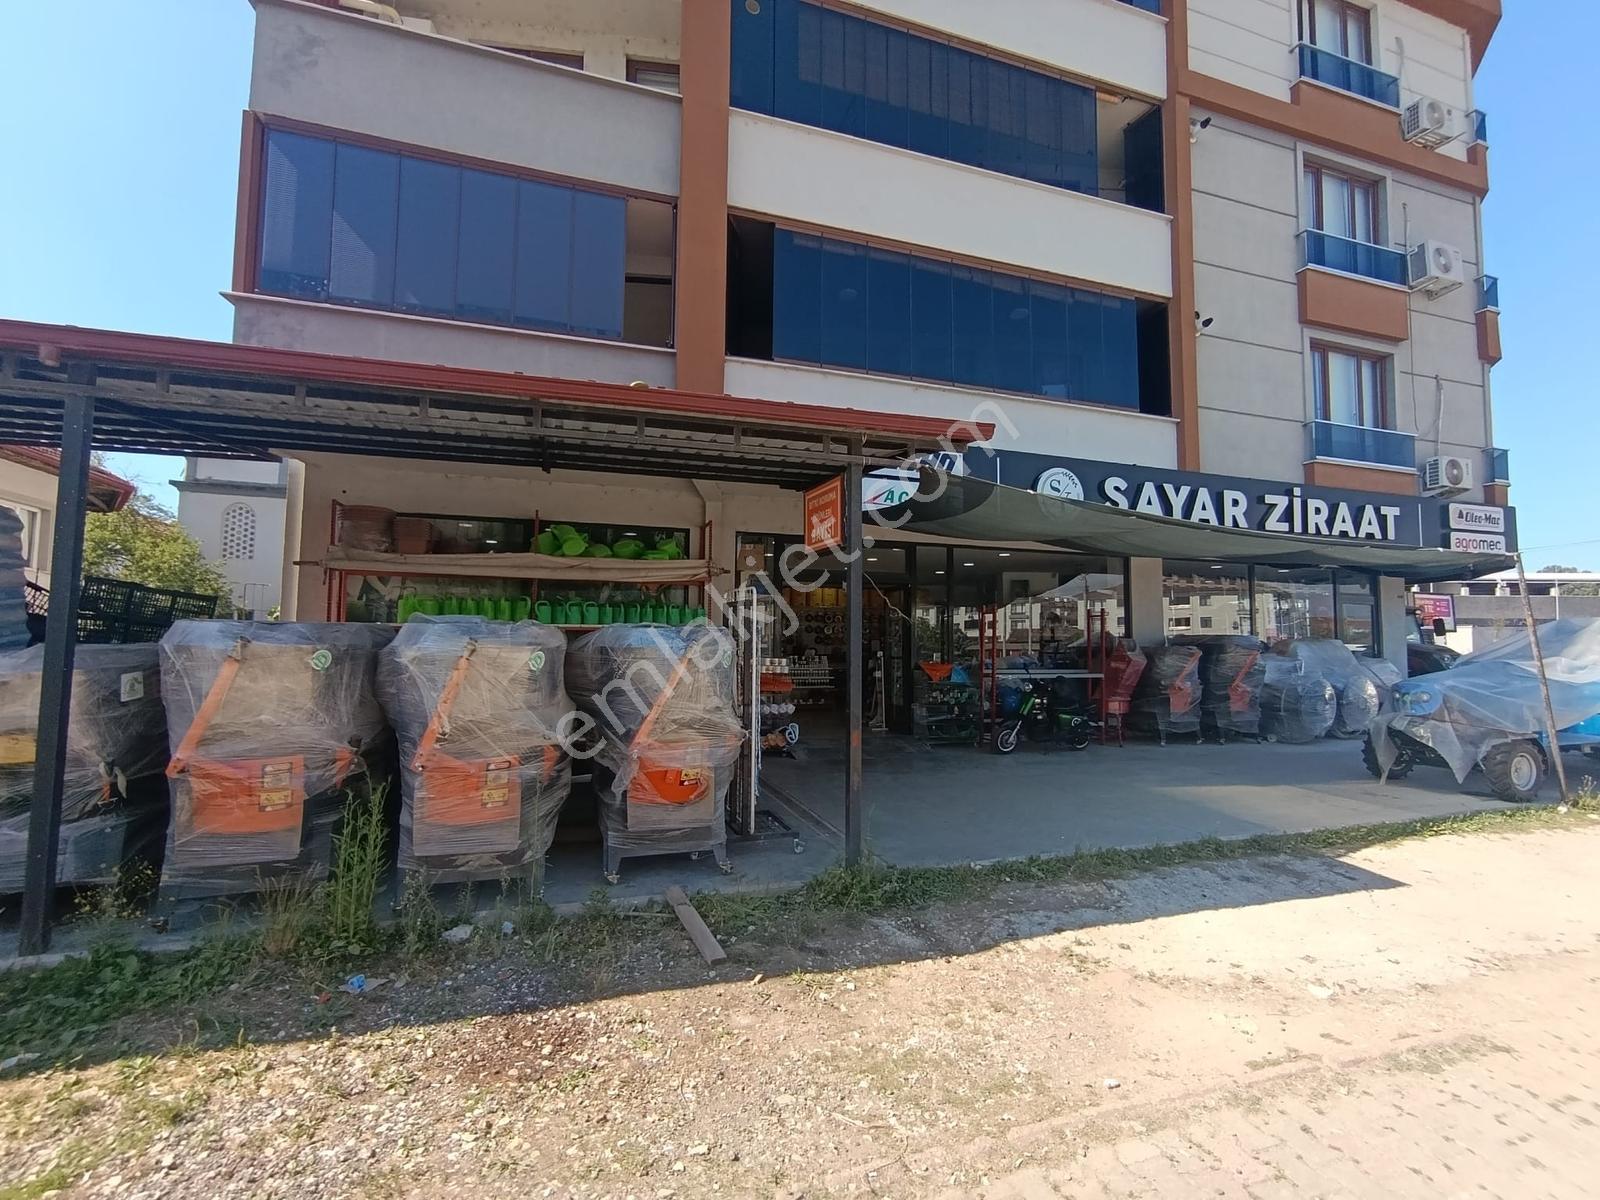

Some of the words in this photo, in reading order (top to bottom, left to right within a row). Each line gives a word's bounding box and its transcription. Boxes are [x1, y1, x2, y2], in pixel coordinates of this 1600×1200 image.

[1103, 476, 1249, 529] SAYAR
[1264, 487, 1401, 541] ZİRAAT
[1455, 537, 1502, 552] agromec
